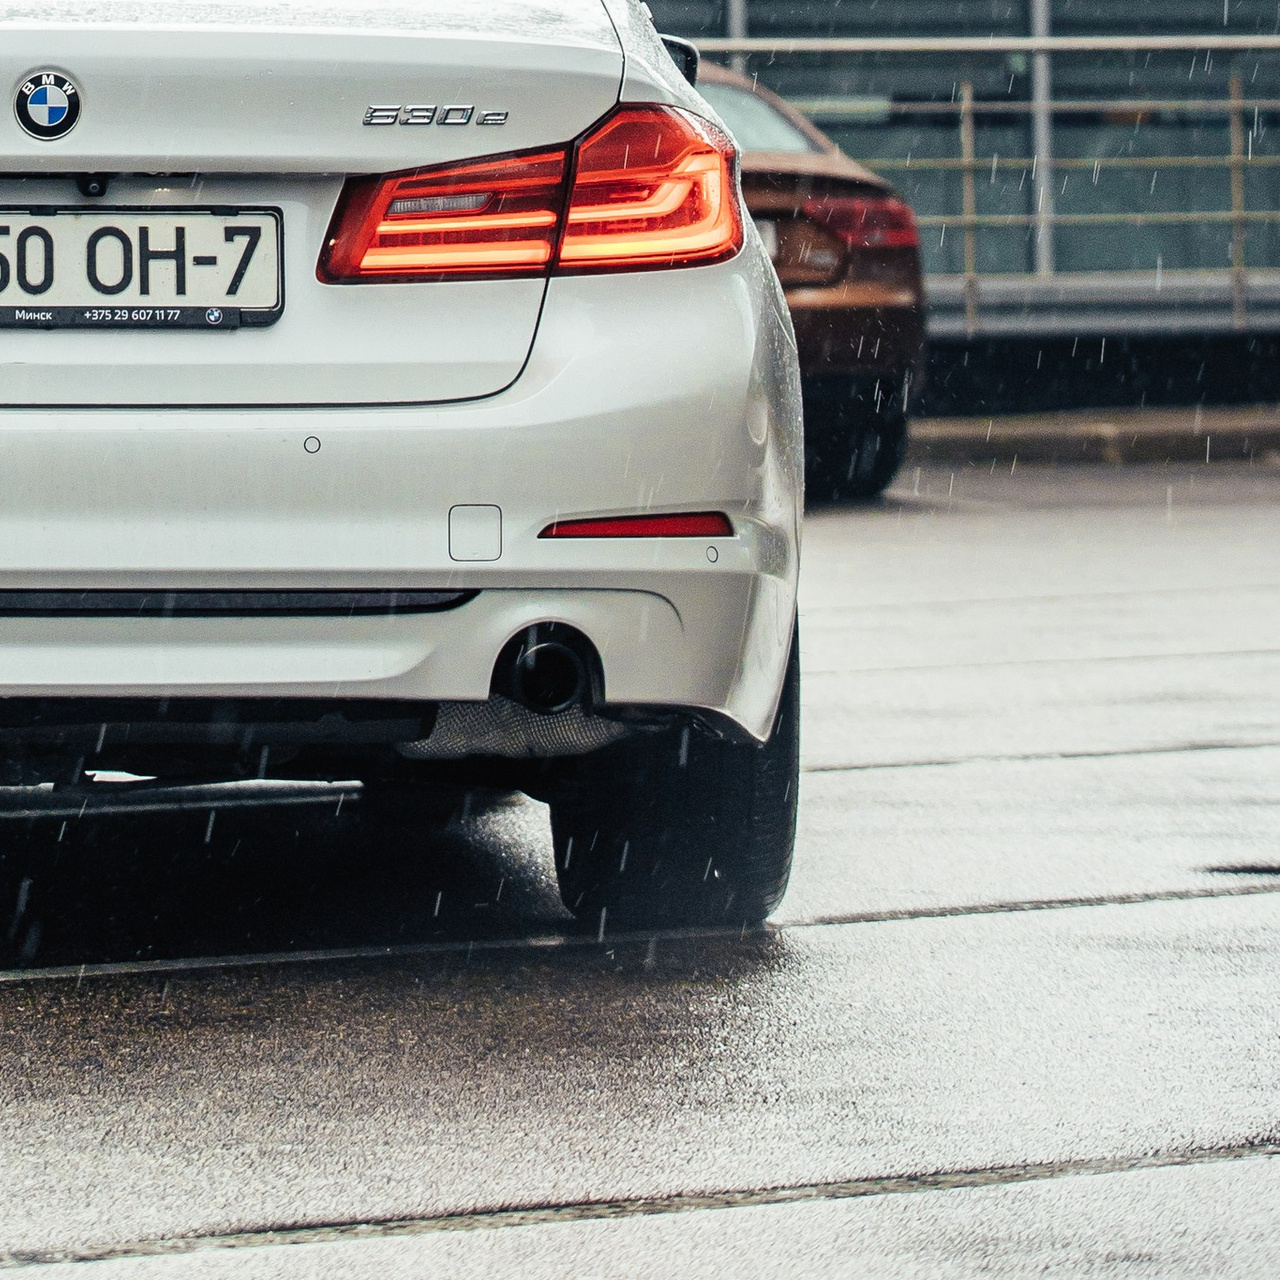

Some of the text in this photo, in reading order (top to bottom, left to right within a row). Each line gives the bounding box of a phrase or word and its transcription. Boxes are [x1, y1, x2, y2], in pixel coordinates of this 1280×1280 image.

[22, 74, 75, 96] BMW
[86, 226, 261, 295] OH-7
[15, 310, 52, 321] Минск
[84, 310, 112, 321] +375
[114, 310, 128, 321] 29
[131, 310, 153, 321] 607
[155, 310, 165, 321] 11
[167, 310, 180, 321] 77
